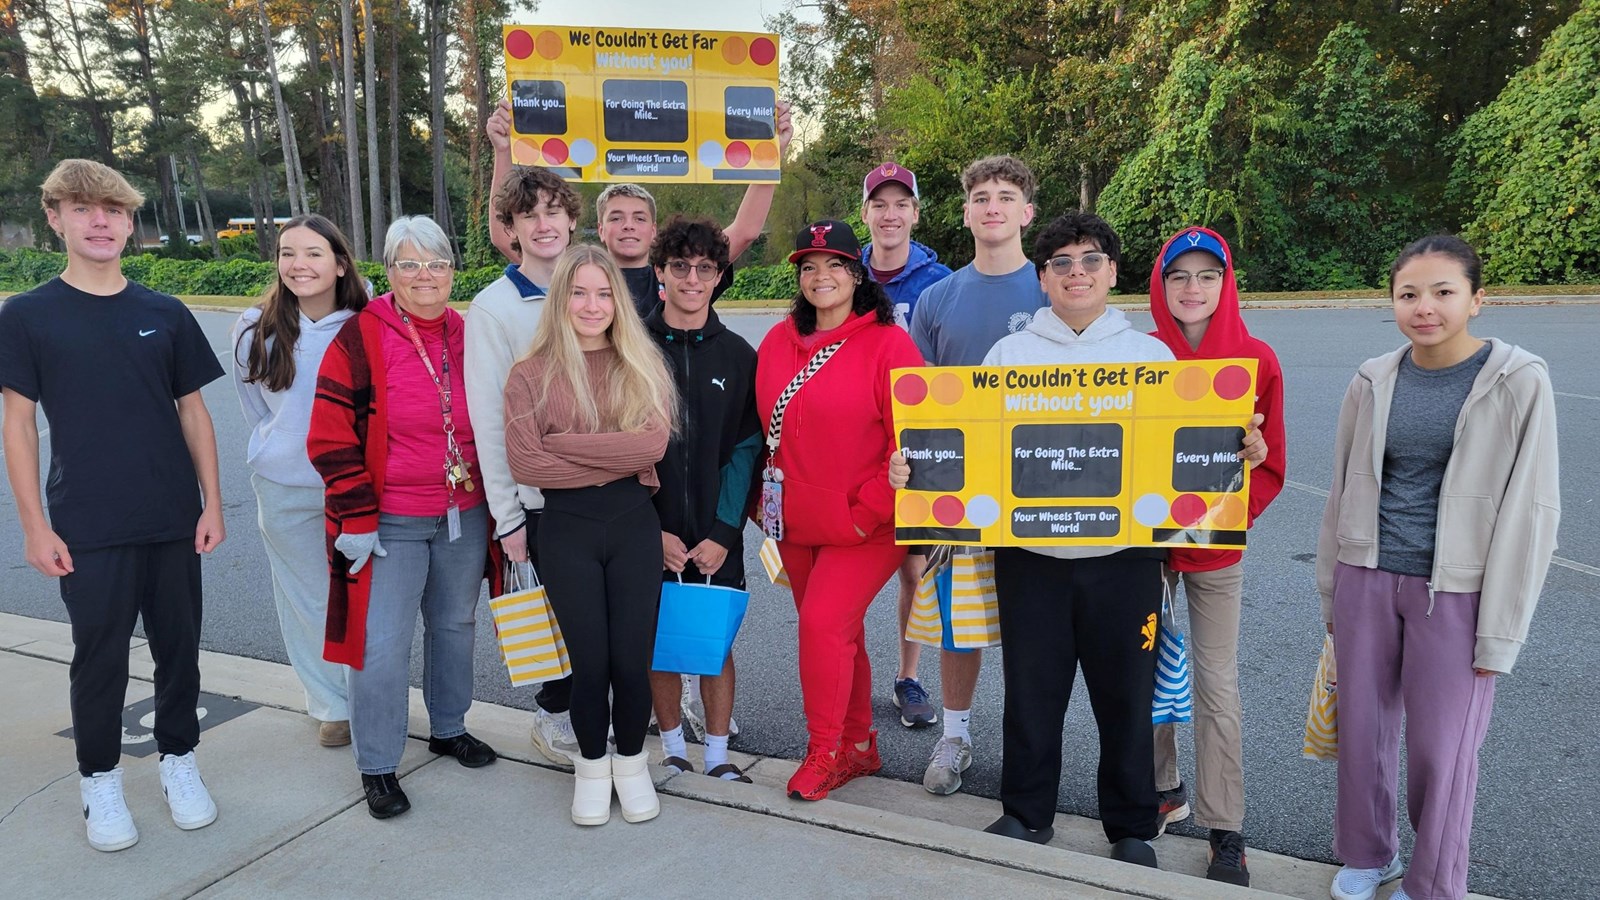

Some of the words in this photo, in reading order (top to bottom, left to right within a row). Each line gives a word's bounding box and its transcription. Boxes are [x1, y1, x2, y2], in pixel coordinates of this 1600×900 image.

[569, 30, 591, 47] We
[595, 31, 657, 49] Couldn't
[662, 34, 689, 49] Get
[693, 33, 718, 51] Far
[596, 53, 655, 69] Without
[660, 55, 693, 74] you!
[512, 97, 540, 108] Thank
[542, 98, 565, 111] you...
[606, 99, 620, 109] For
[622, 99, 644, 111] Going
[646, 100, 661, 110] The
[663, 99, 686, 110] Extra
[634, 111, 658, 120] Mile...
[727, 106, 751, 118] Every
[753, 107, 773, 117] Mile!
[607, 154, 625, 163] Your
[627, 154, 653, 164] Wheels
[654, 154, 671, 163] Turn
[673, 154, 687, 164] Our
[636, 164, 659, 173] World
[972, 372, 1000, 389] We
[1005, 368, 1088, 389] Couldn't
[1094, 368, 1130, 386] Get
[1134, 366, 1169, 385] Far
[1005, 392, 1084, 412] Without
[1089, 390, 1133, 416] you!
[901, 446, 933, 460] Thank
[935, 449, 964, 462] you...
[1015, 447, 1033, 459] For
[1035, 447, 1064, 460] Going
[1067, 447, 1086, 458] The
[1088, 447, 1119, 459] Extra
[1176, 452, 1210, 467] Every
[1051, 459, 1082, 471] Mile...
[1014, 511, 1038, 522] Your
[1040, 511, 1072, 522] Wheels
[1074, 511, 1097, 522] Turn
[1099, 511, 1118, 522] Our
[1051, 522, 1080, 534] World
